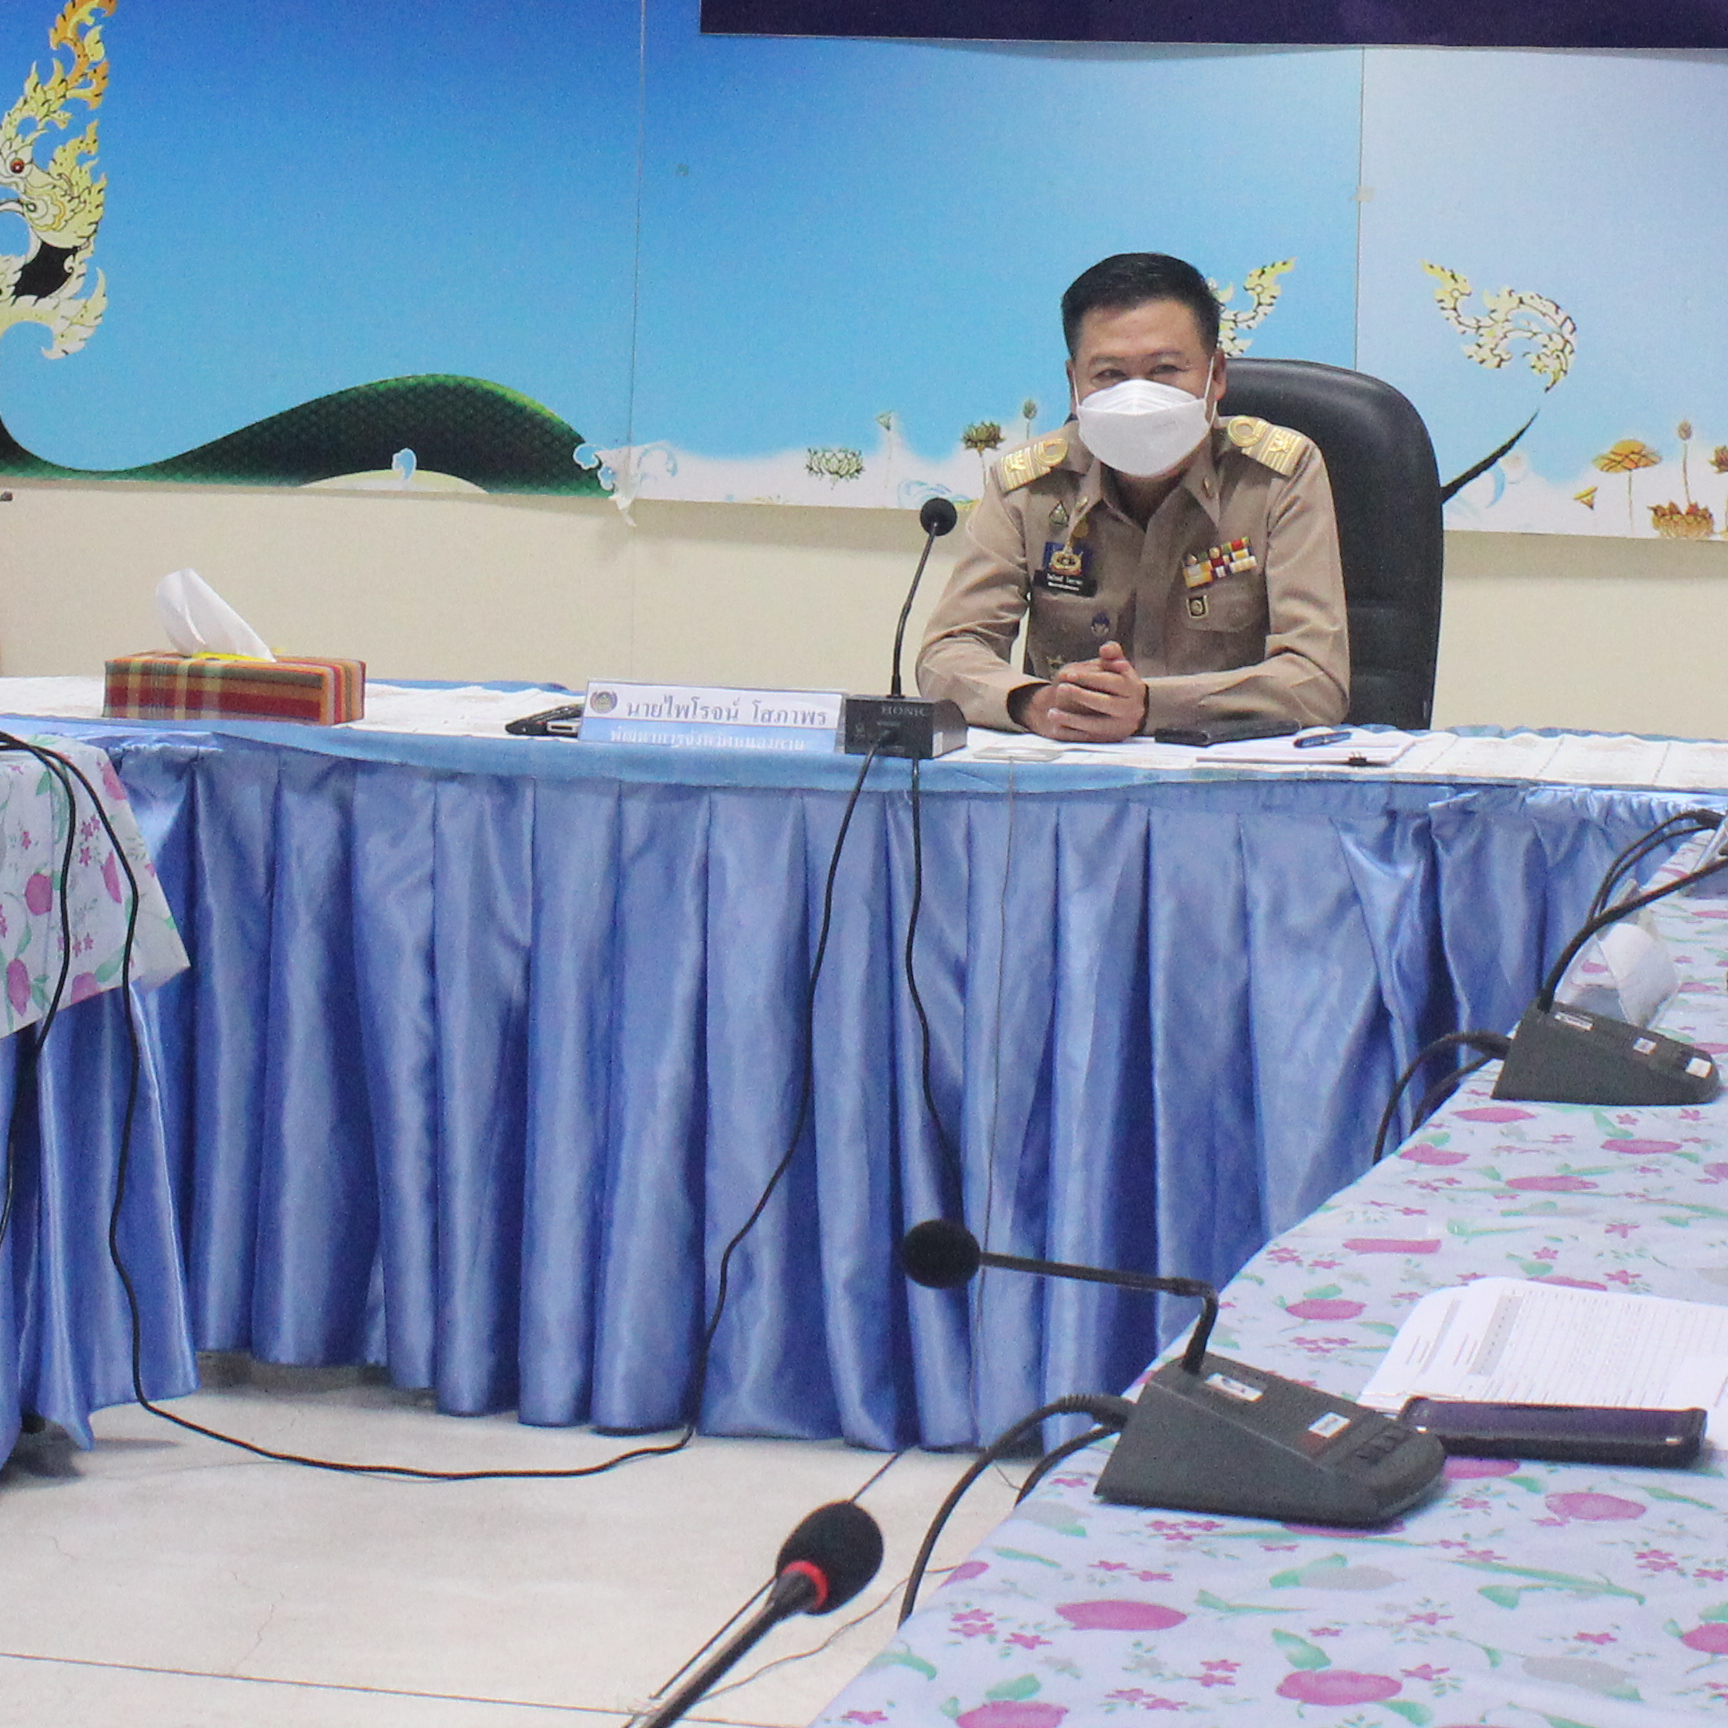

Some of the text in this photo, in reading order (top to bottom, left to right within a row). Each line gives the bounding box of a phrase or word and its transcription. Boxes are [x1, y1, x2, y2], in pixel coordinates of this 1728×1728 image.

[626, 694, 828, 726] นายไพโรจน์ โสภาพร
